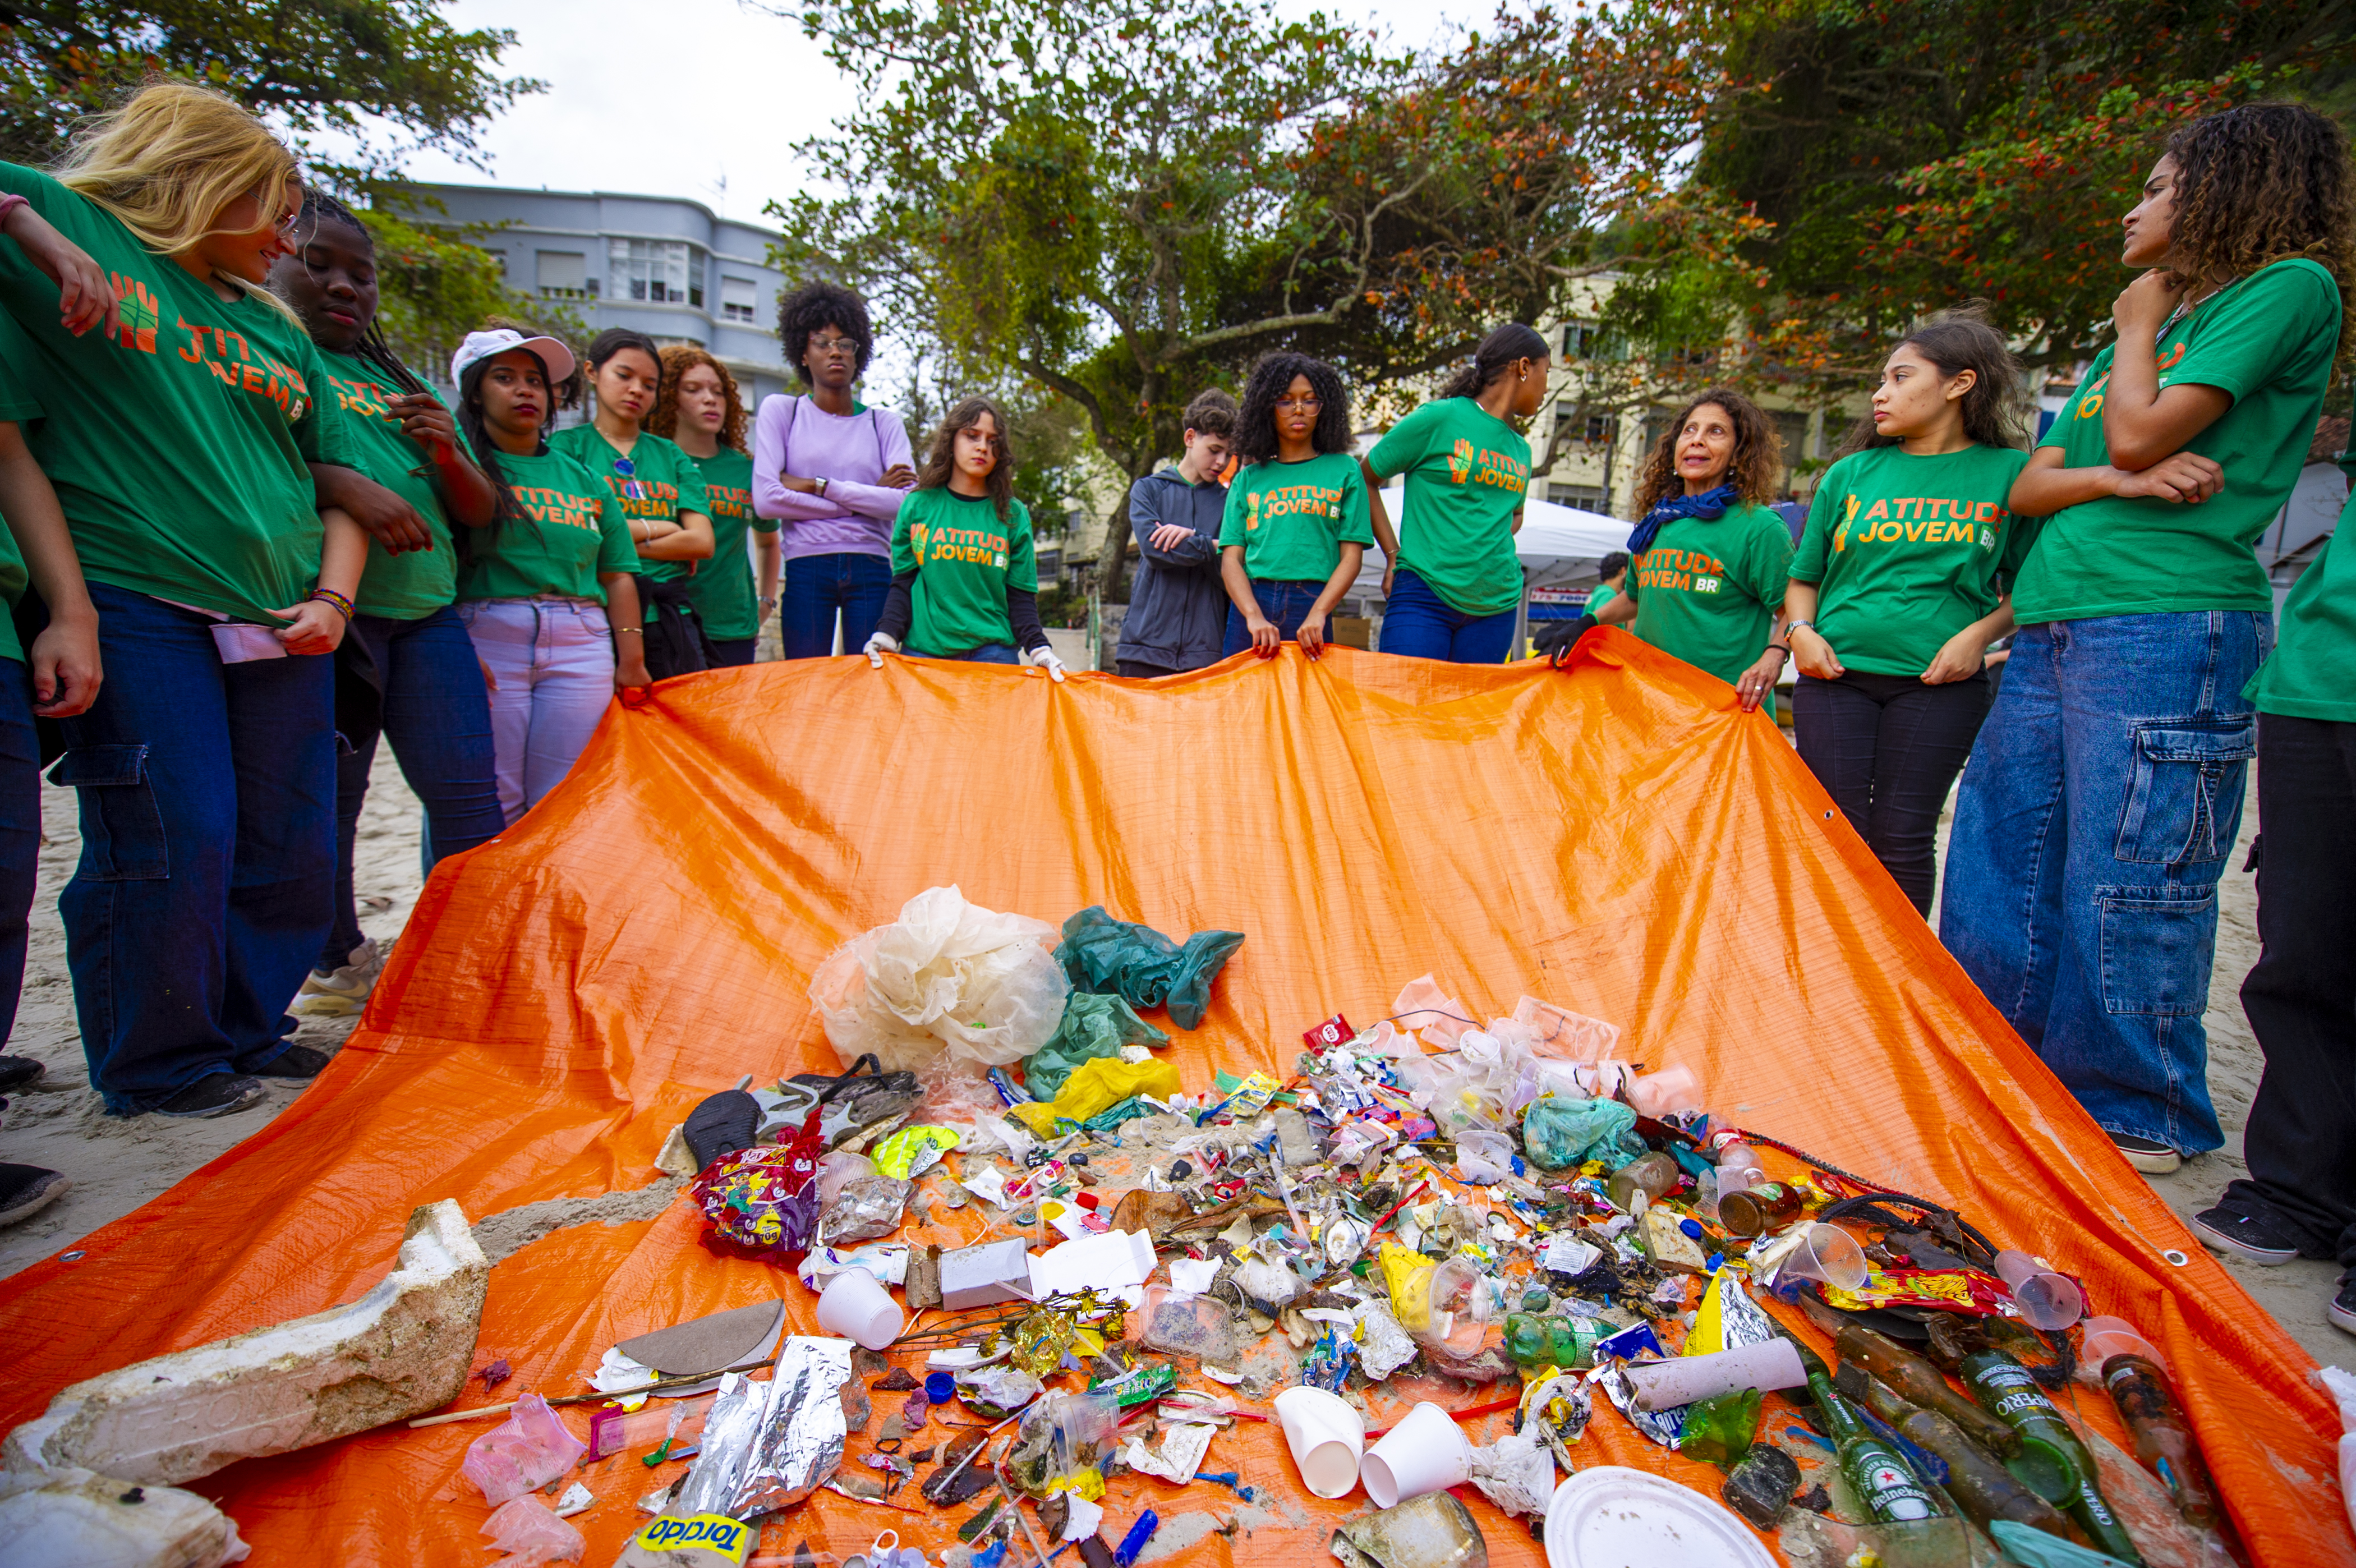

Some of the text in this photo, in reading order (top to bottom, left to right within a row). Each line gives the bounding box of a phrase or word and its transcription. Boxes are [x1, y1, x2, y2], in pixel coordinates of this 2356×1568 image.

[1264, 485, 1344, 504] ATITUD
[1264, 499, 1327, 519] JOVEM
[1858, 521, 1974, 543] JOVEM
[931, 544, 992, 566] JOVEM
[1695, 578, 1718, 593] BR
[759, 1232, 778, 1242] 70g
[1833, 1400, 1855, 1425] Heineken
[1870, 1486, 1932, 1512] Heineken
[646, 1519, 742, 1552] Torcido
